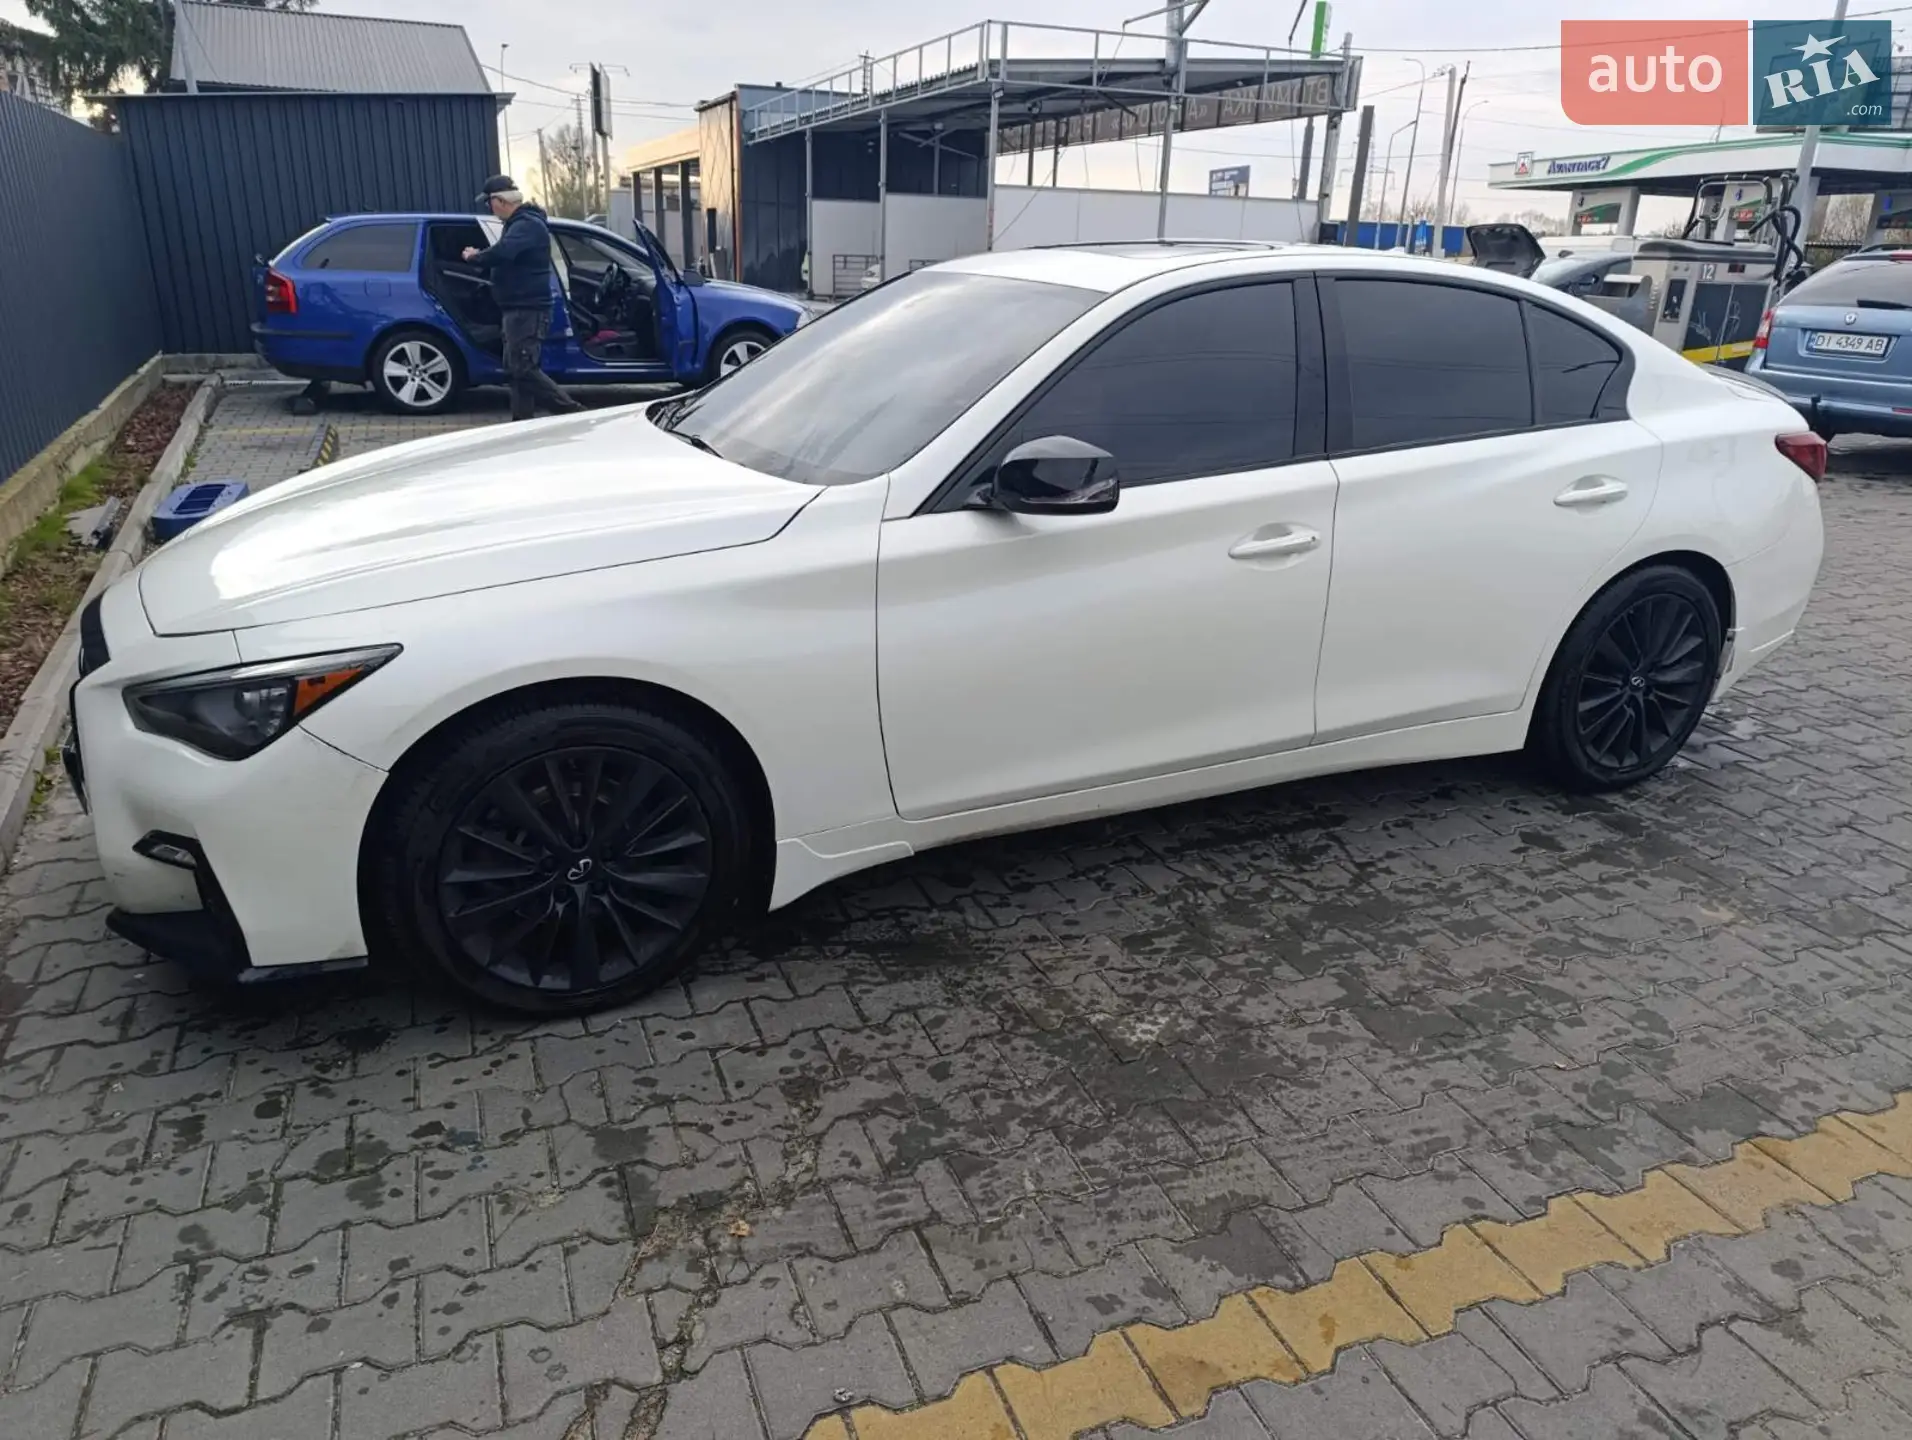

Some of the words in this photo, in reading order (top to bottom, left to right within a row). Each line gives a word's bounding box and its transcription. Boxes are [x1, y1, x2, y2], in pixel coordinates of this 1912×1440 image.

[1702, 264, 1715, 280] 12
[1836, 336, 1864, 349] 4349
[1865, 339, 1885, 351] AB
